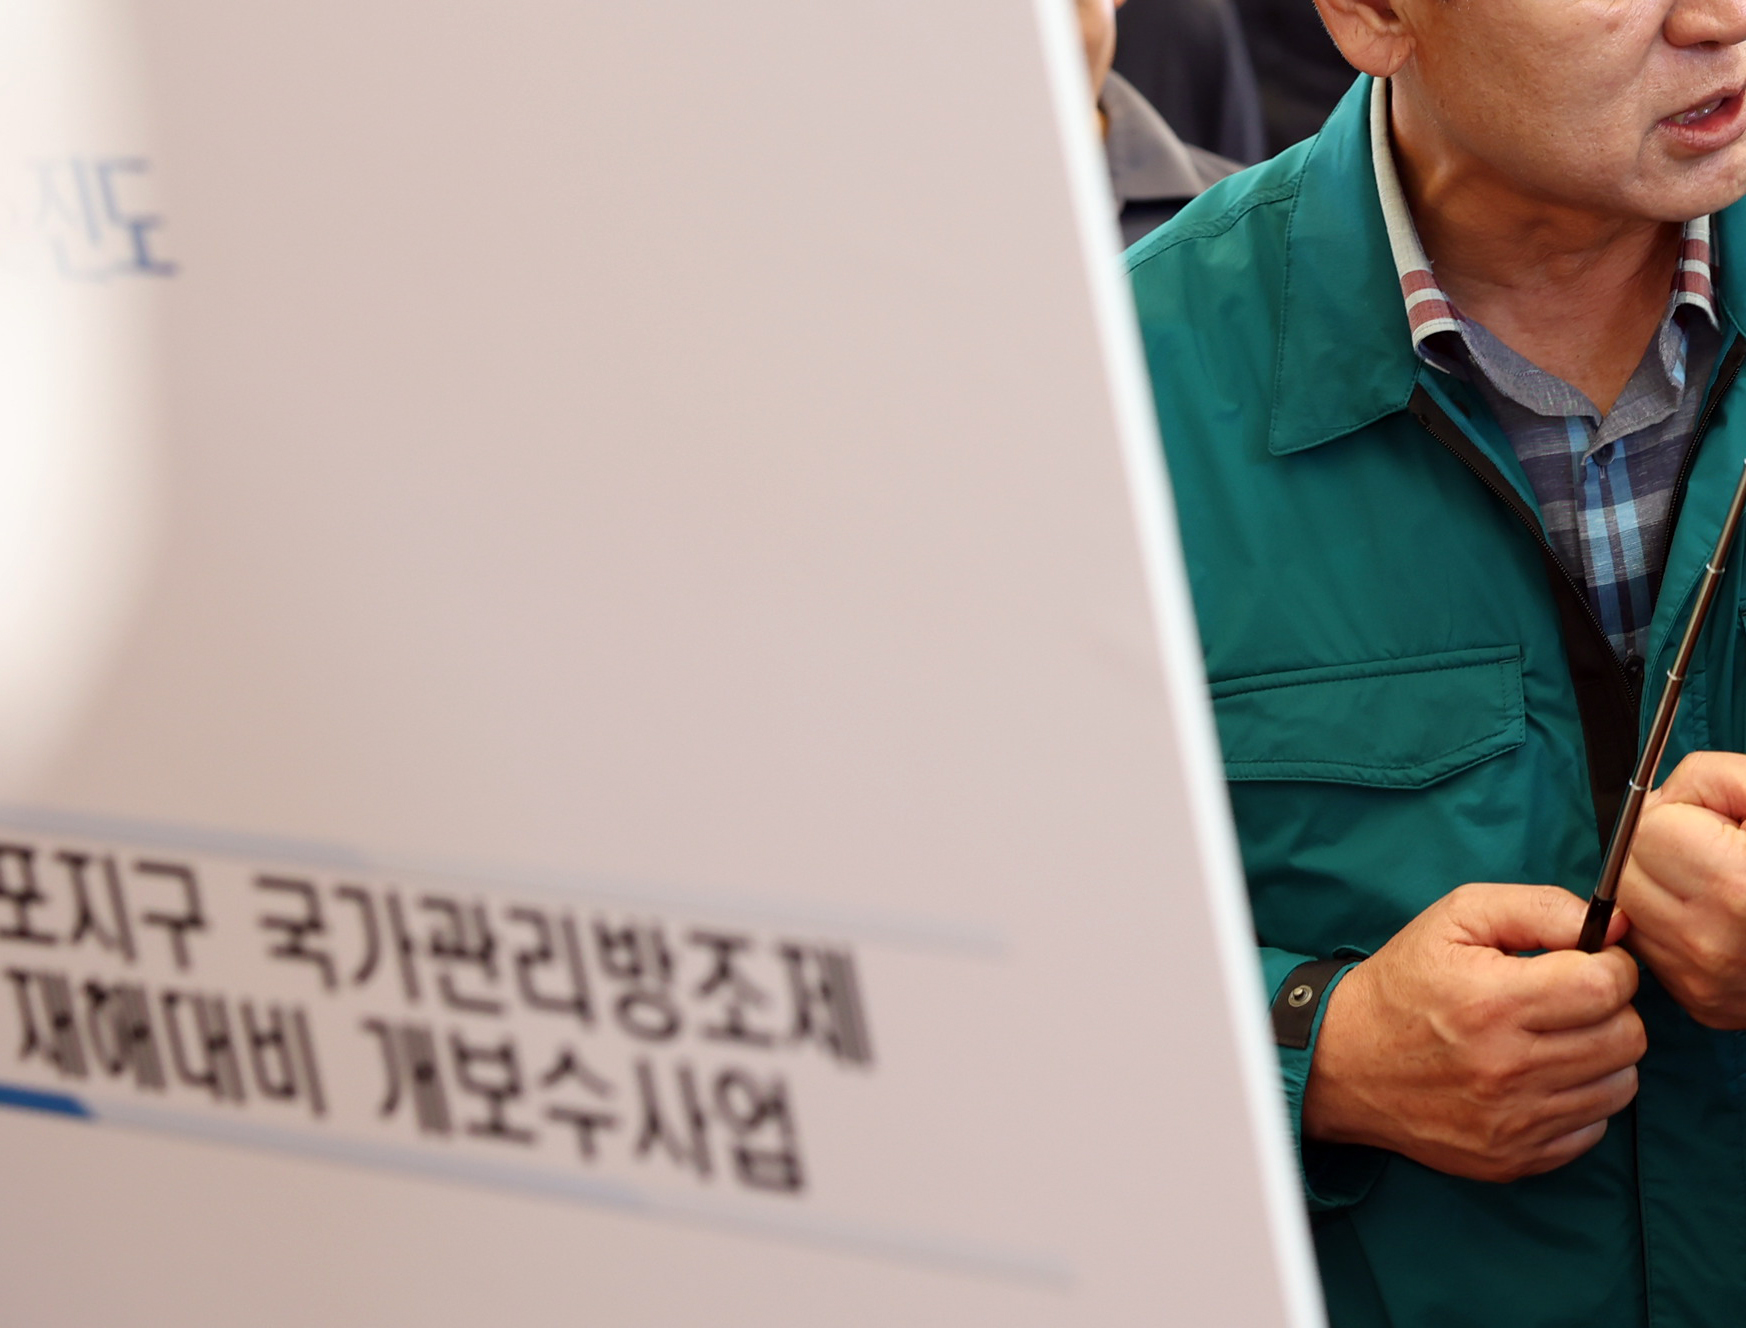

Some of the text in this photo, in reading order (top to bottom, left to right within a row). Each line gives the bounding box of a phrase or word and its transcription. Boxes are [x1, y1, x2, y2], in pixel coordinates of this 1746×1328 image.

[253, 873, 872, 1068] 국가관리방조제
[6, 968, 808, 1196] 재해대비 개보수사업
